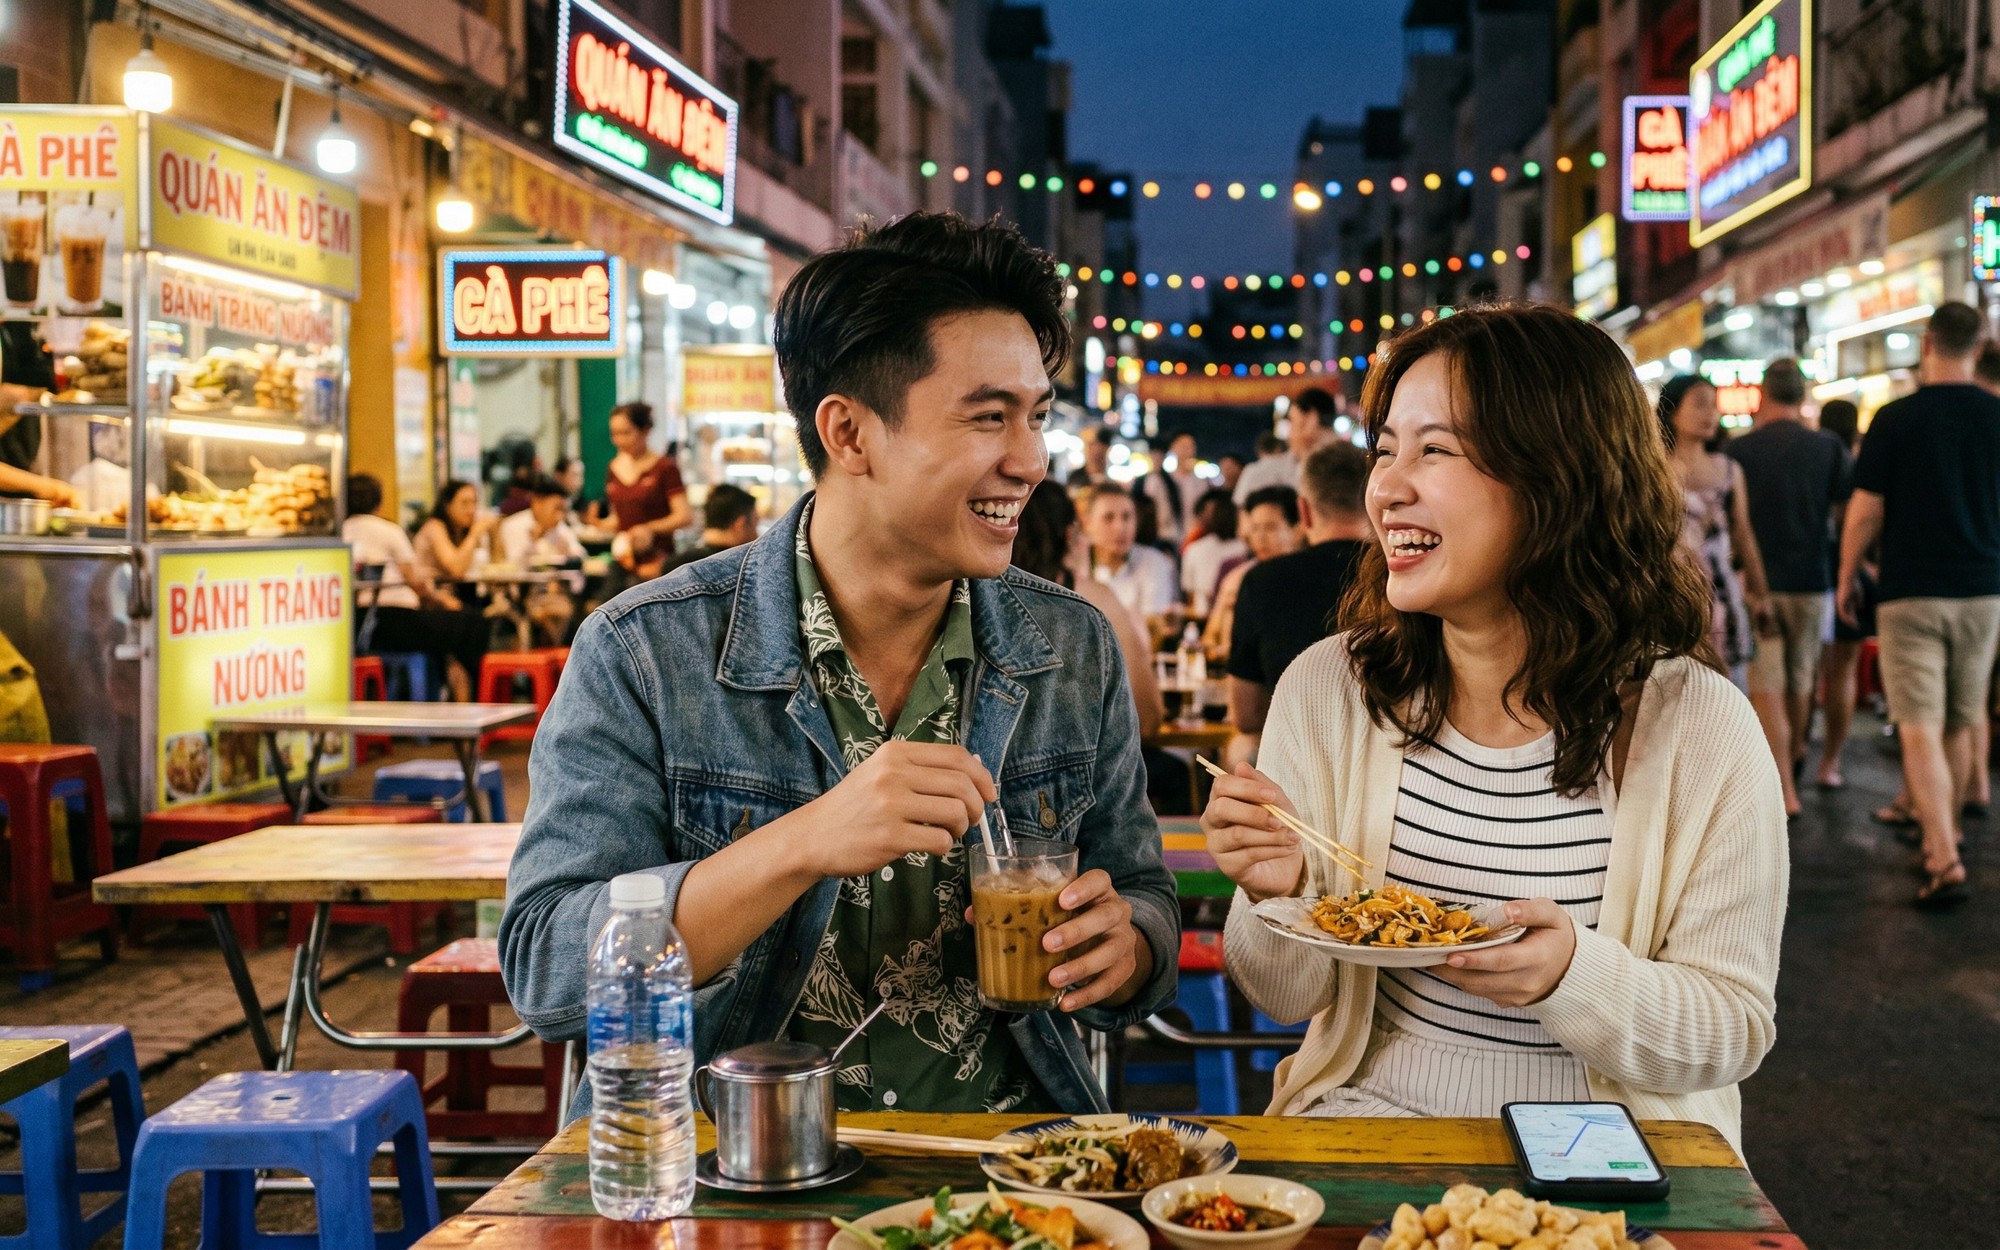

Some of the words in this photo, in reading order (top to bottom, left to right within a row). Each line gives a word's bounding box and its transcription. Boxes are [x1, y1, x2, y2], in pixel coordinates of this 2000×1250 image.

[41, 125, 117, 176] PHÊ
[160, 152, 242, 225] QUÁN
[254, 171, 288, 236] ĂN
[298, 191, 350, 254] ĐÊM
[454, 265, 517, 335] CÀ
[522, 265, 610, 334] PHÊ
[171, 569, 249, 635] BÁNH
[260, 565, 341, 625] TRÁNG
[215, 642, 304, 705] NƯỚNG
